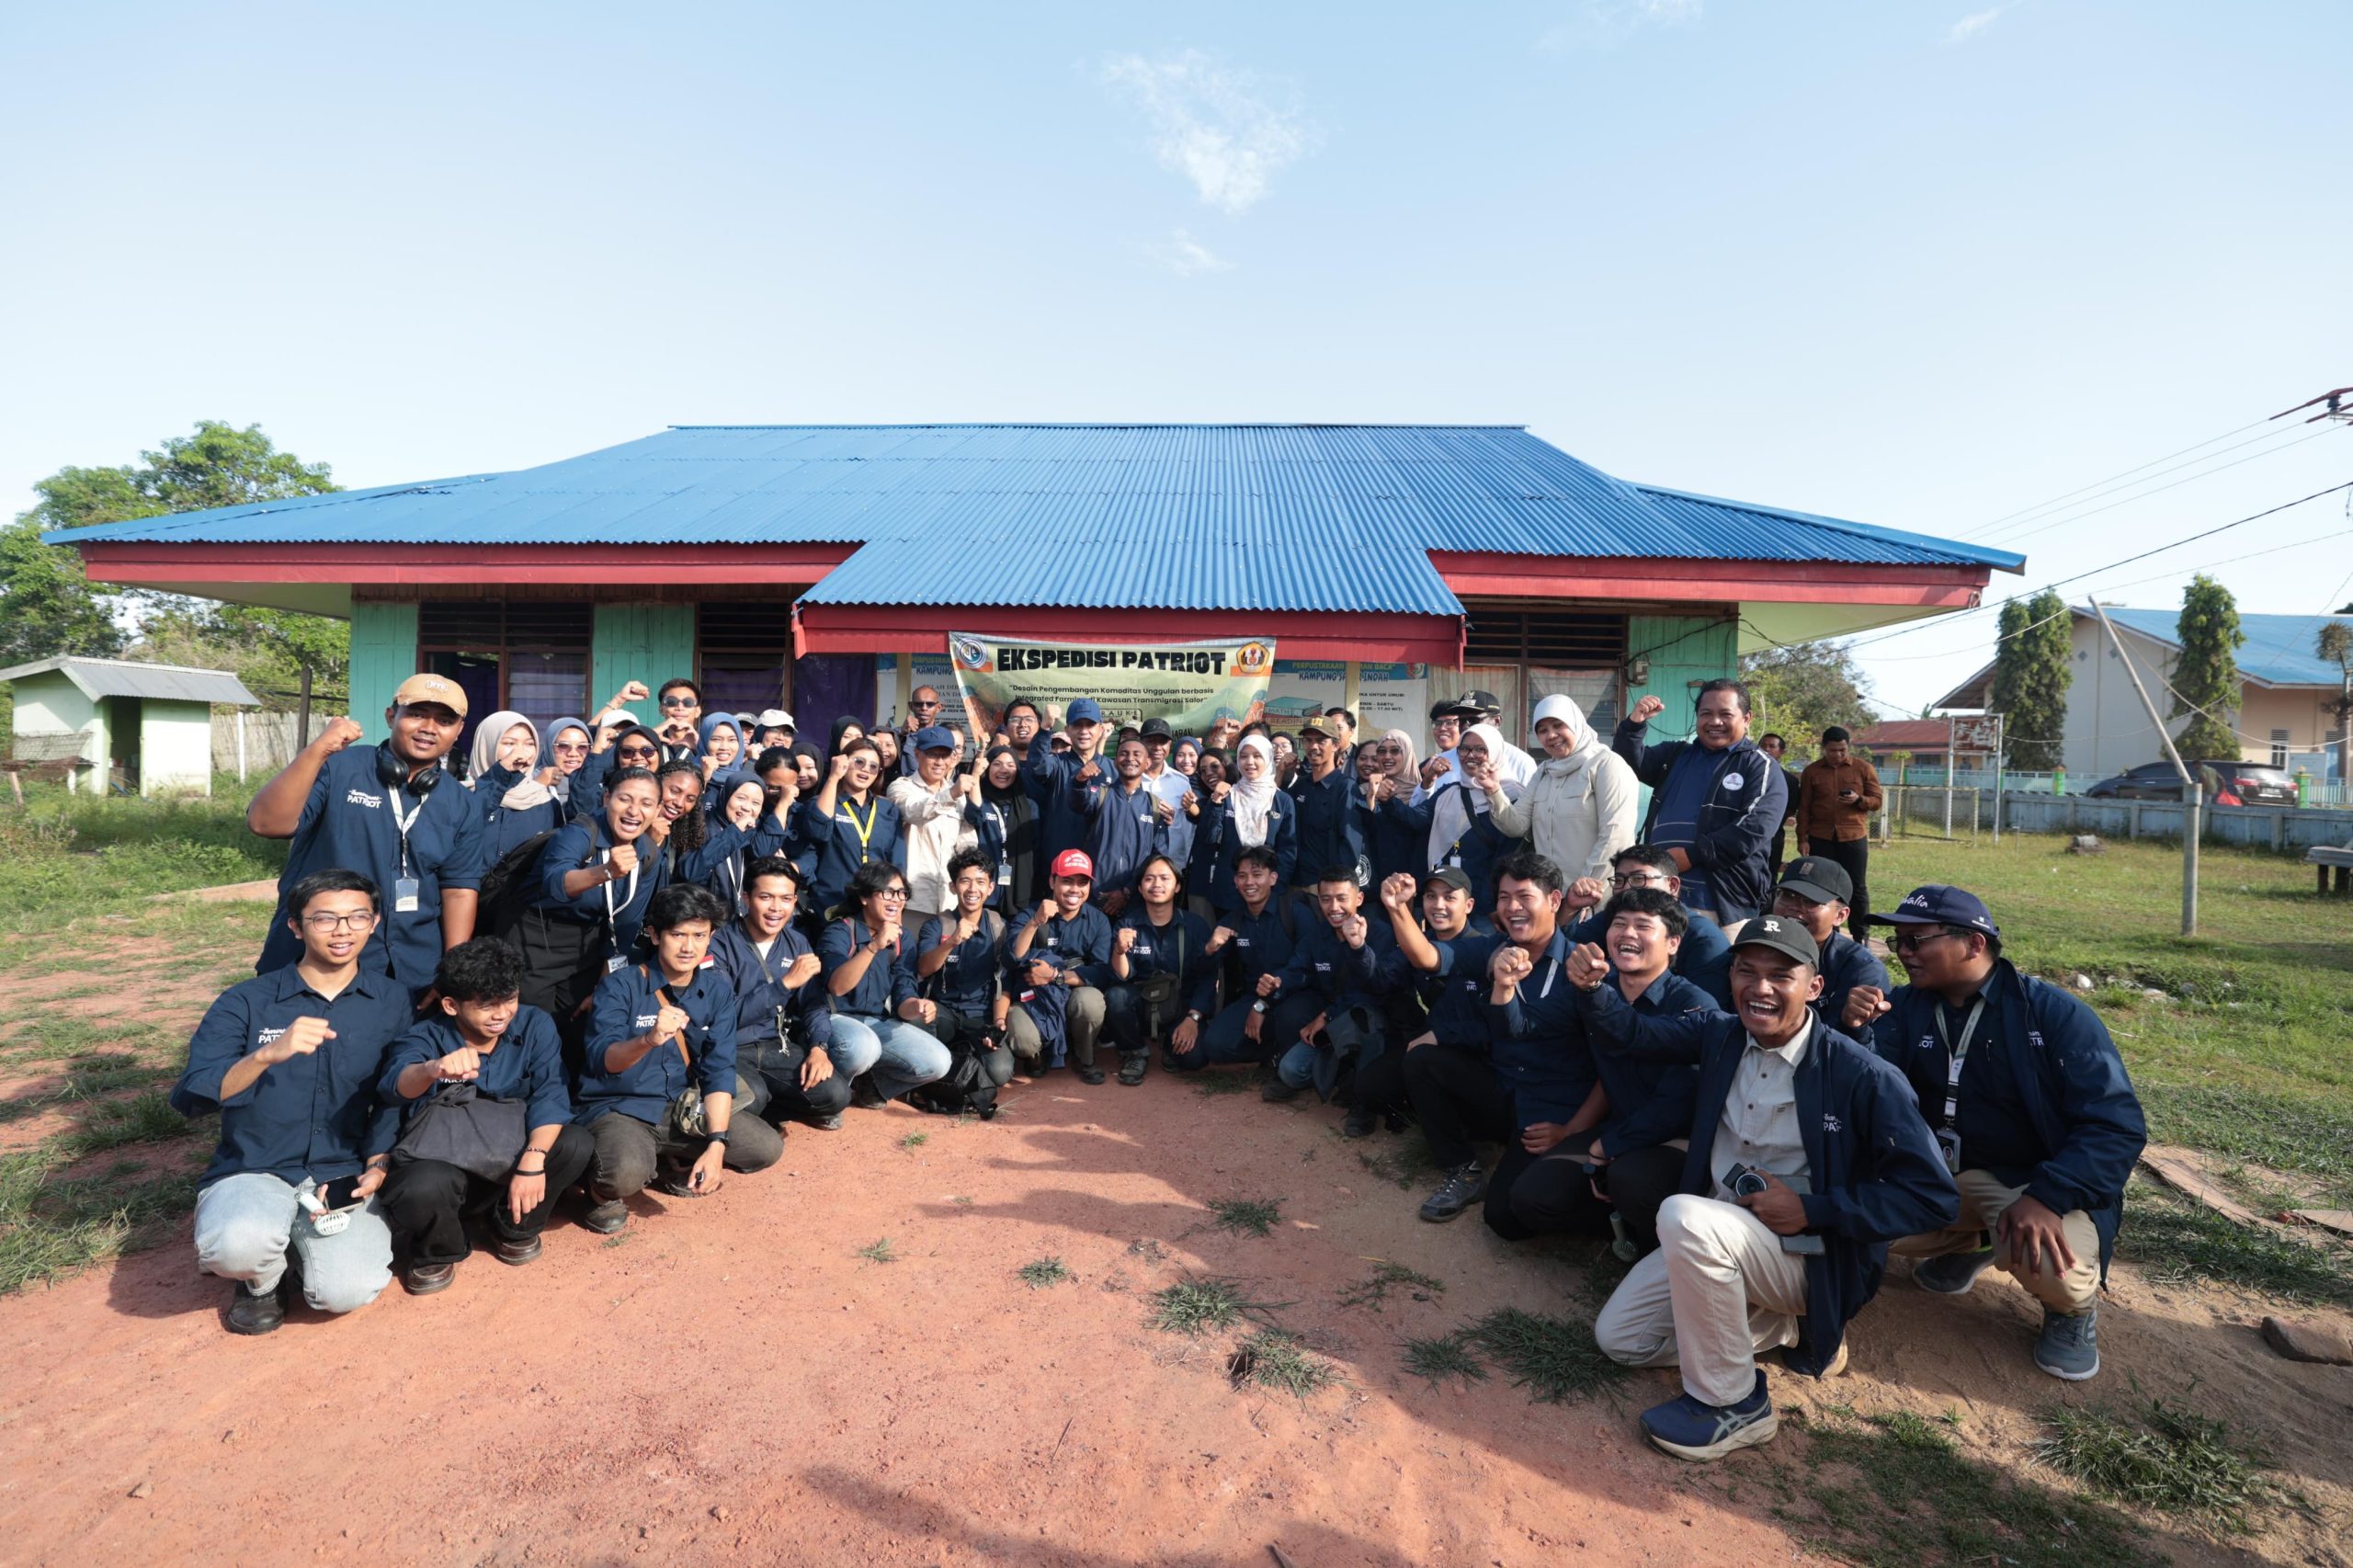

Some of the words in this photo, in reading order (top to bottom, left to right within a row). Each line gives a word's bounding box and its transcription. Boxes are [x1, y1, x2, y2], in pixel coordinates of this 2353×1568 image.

[997, 648, 1117, 672] EKSPEDISI
[1122, 652, 1226, 676] PATRIOT
[1040, 686, 1099, 695] Pengembangan
[1142, 687, 1180, 696] Unggulan
[1181, 687, 1214, 695] berbasis
[1133, 697, 1183, 705] Transmigrasi
[347, 794, 382, 809] PATRIOT
[1764, 920, 1781, 933] R
